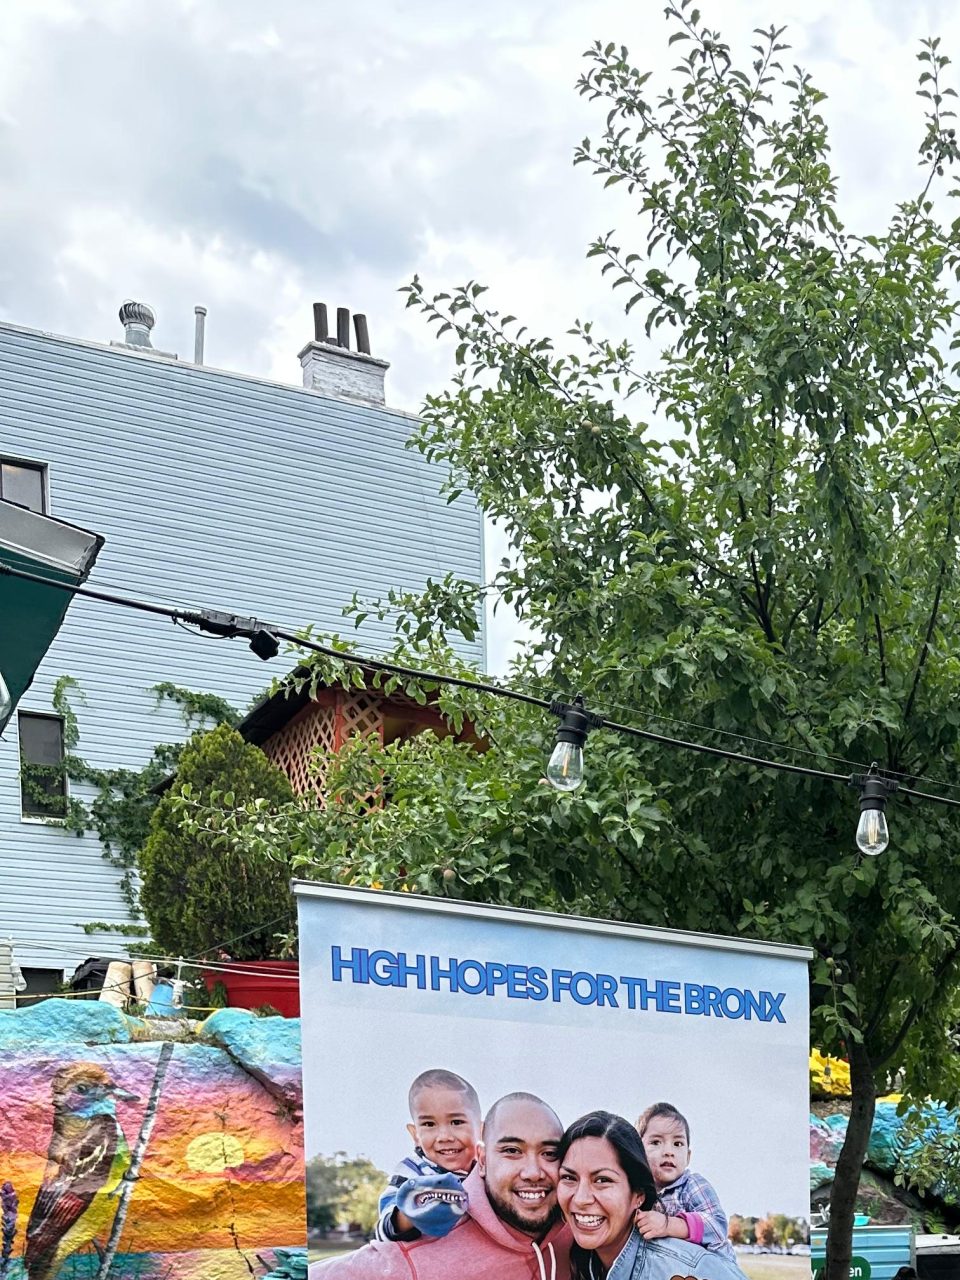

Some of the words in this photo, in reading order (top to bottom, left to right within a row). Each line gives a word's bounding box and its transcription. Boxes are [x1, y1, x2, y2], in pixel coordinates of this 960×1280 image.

[331, 945, 426, 990] HIGH
[432, 956, 549, 1001] HOPES
[552, 968, 618, 1008] FOR
[620, 976, 682, 1015] THE
[684, 982, 787, 1023] BRONX
